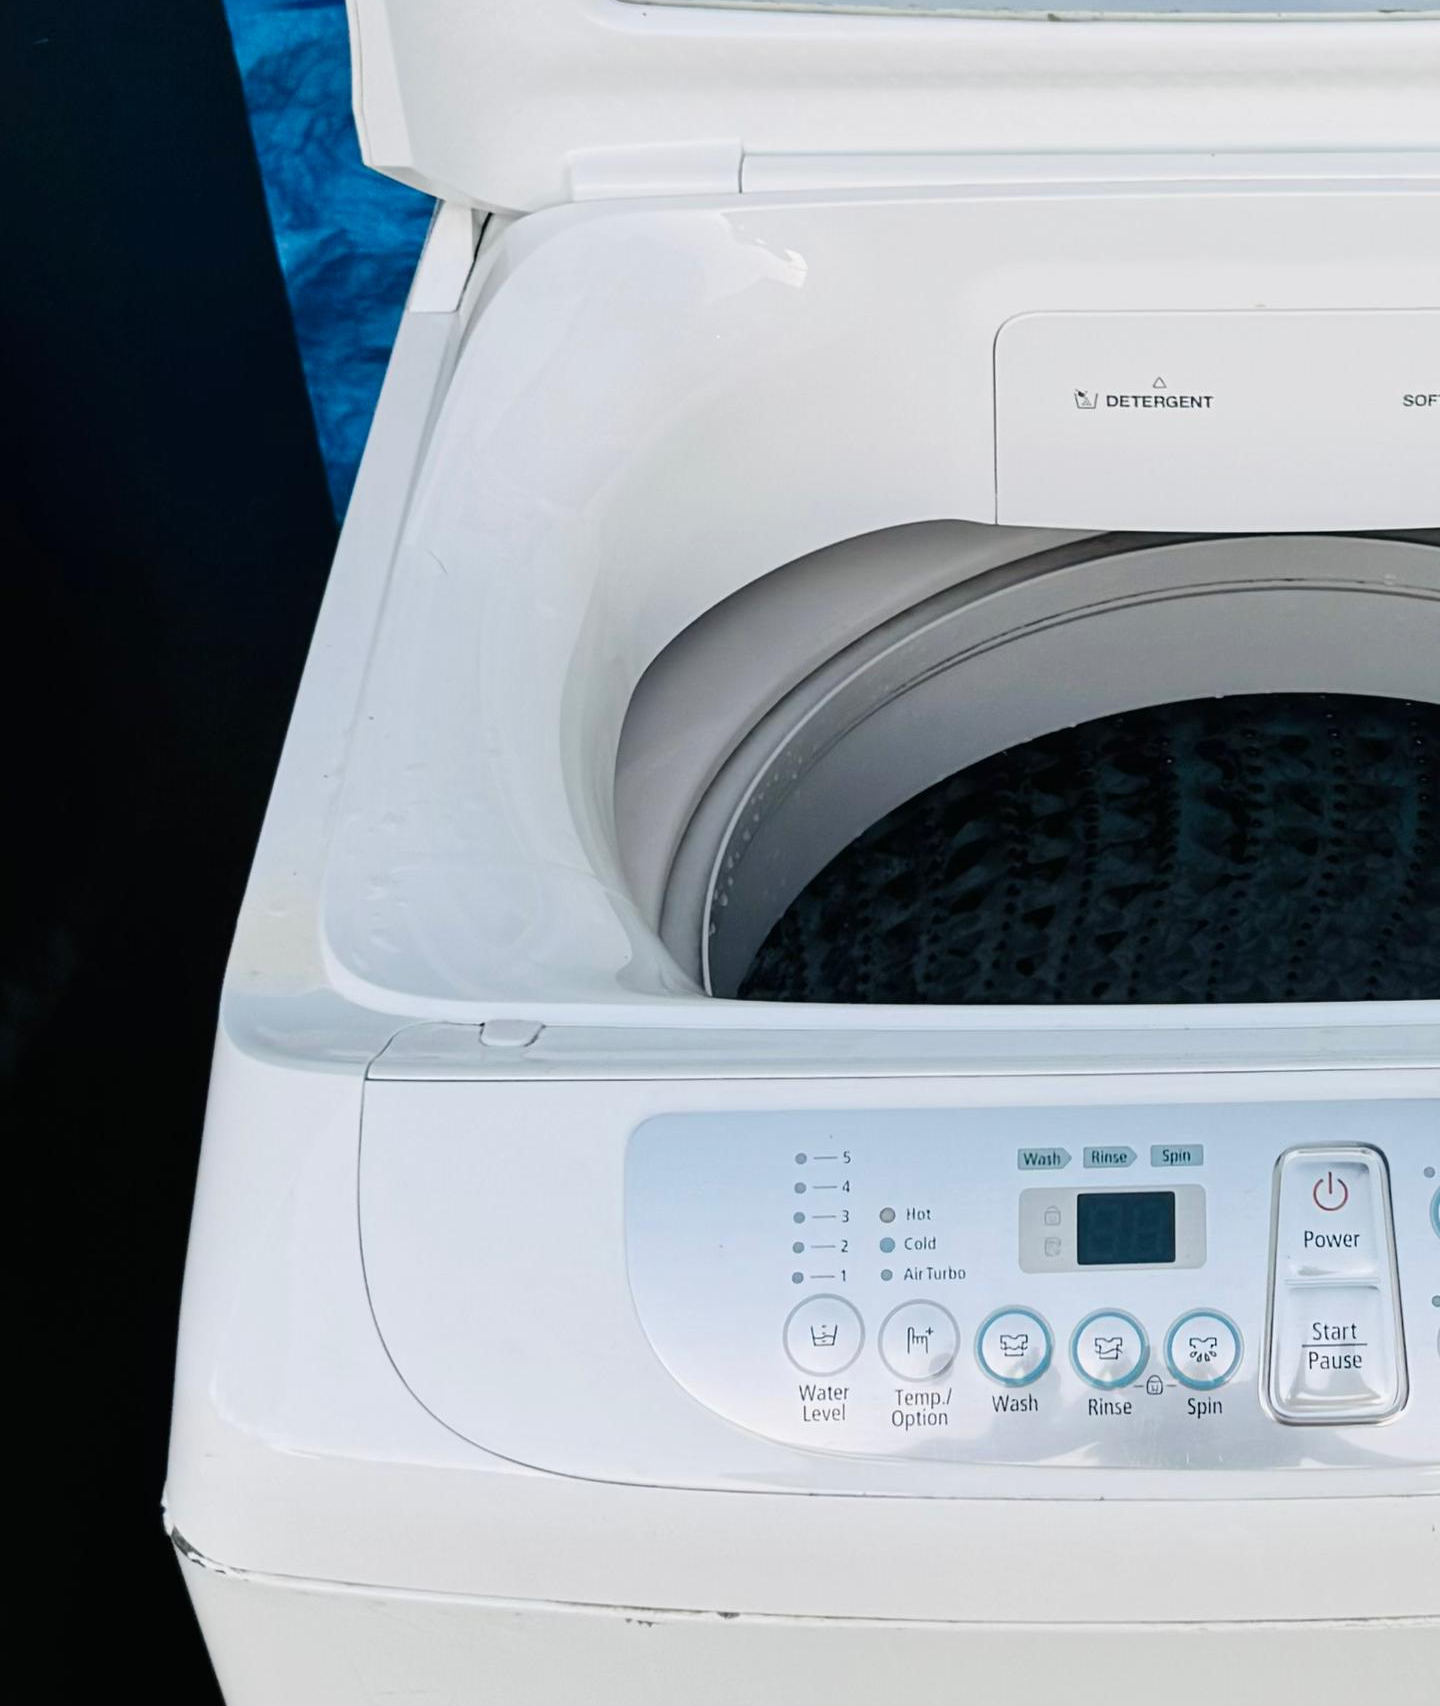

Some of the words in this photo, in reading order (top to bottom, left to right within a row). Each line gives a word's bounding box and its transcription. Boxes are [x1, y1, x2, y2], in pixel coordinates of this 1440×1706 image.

[1106, 394, 1214, 409] DETERGENT
[843, 1150, 852, 1164] 5
[1023, 1151, 1061, 1166] Wash
[1091, 1150, 1128, 1164] Rinse
[1162, 1148, 1191, 1166] Spin
[842, 1180, 850, 1193] 4
[842, 1209, 850, 1223] 3
[906, 1207, 931, 1221] Hot
[840, 1239, 849, 1253] 2
[904, 1236, 937, 1251] Cold
[1303, 1230, 1361, 1248] Power
[903, 1267, 923, 1281] Air
[926, 1266, 967, 1280] Turbo
[1312, 1321, 1357, 1341] Start
[1308, 1351, 1363, 1370] Pause
[798, 1384, 850, 1402] Water
[895, 1387, 953, 1410] Temp./
[803, 1402, 846, 1422] Level
[992, 1393, 1039, 1413] Wash
[1088, 1397, 1133, 1416] Rinse
[1187, 1397, 1223, 1420] Spin
[891, 1407, 949, 1431] Option
